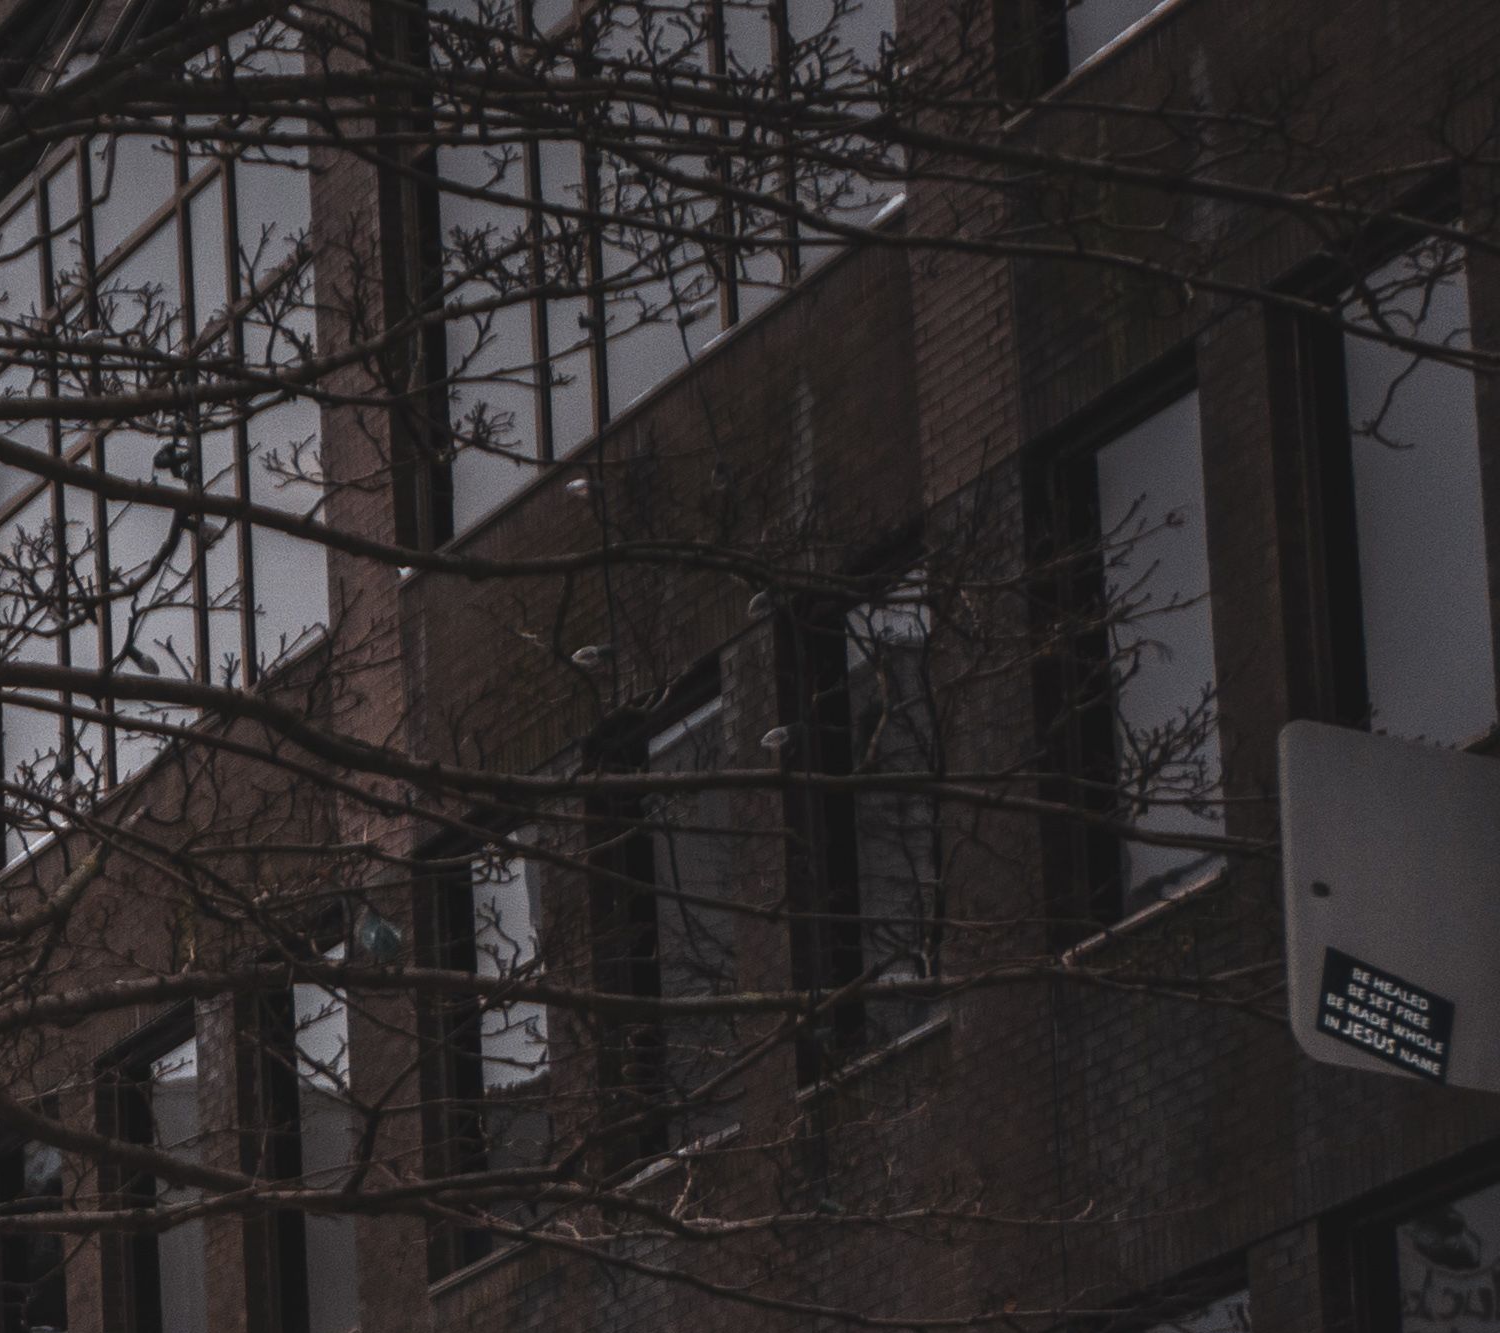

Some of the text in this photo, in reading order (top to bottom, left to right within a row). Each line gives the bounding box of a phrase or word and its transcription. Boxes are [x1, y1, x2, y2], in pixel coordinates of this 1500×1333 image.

[1347, 983, 1430, 1030] BE SET FREE
[1352, 967, 1429, 1011] BE HEALED
[1324, 1013, 1441, 1076] IN JESUS NAME
[1326, 992, 1444, 1055] BE MADE WHOLE
